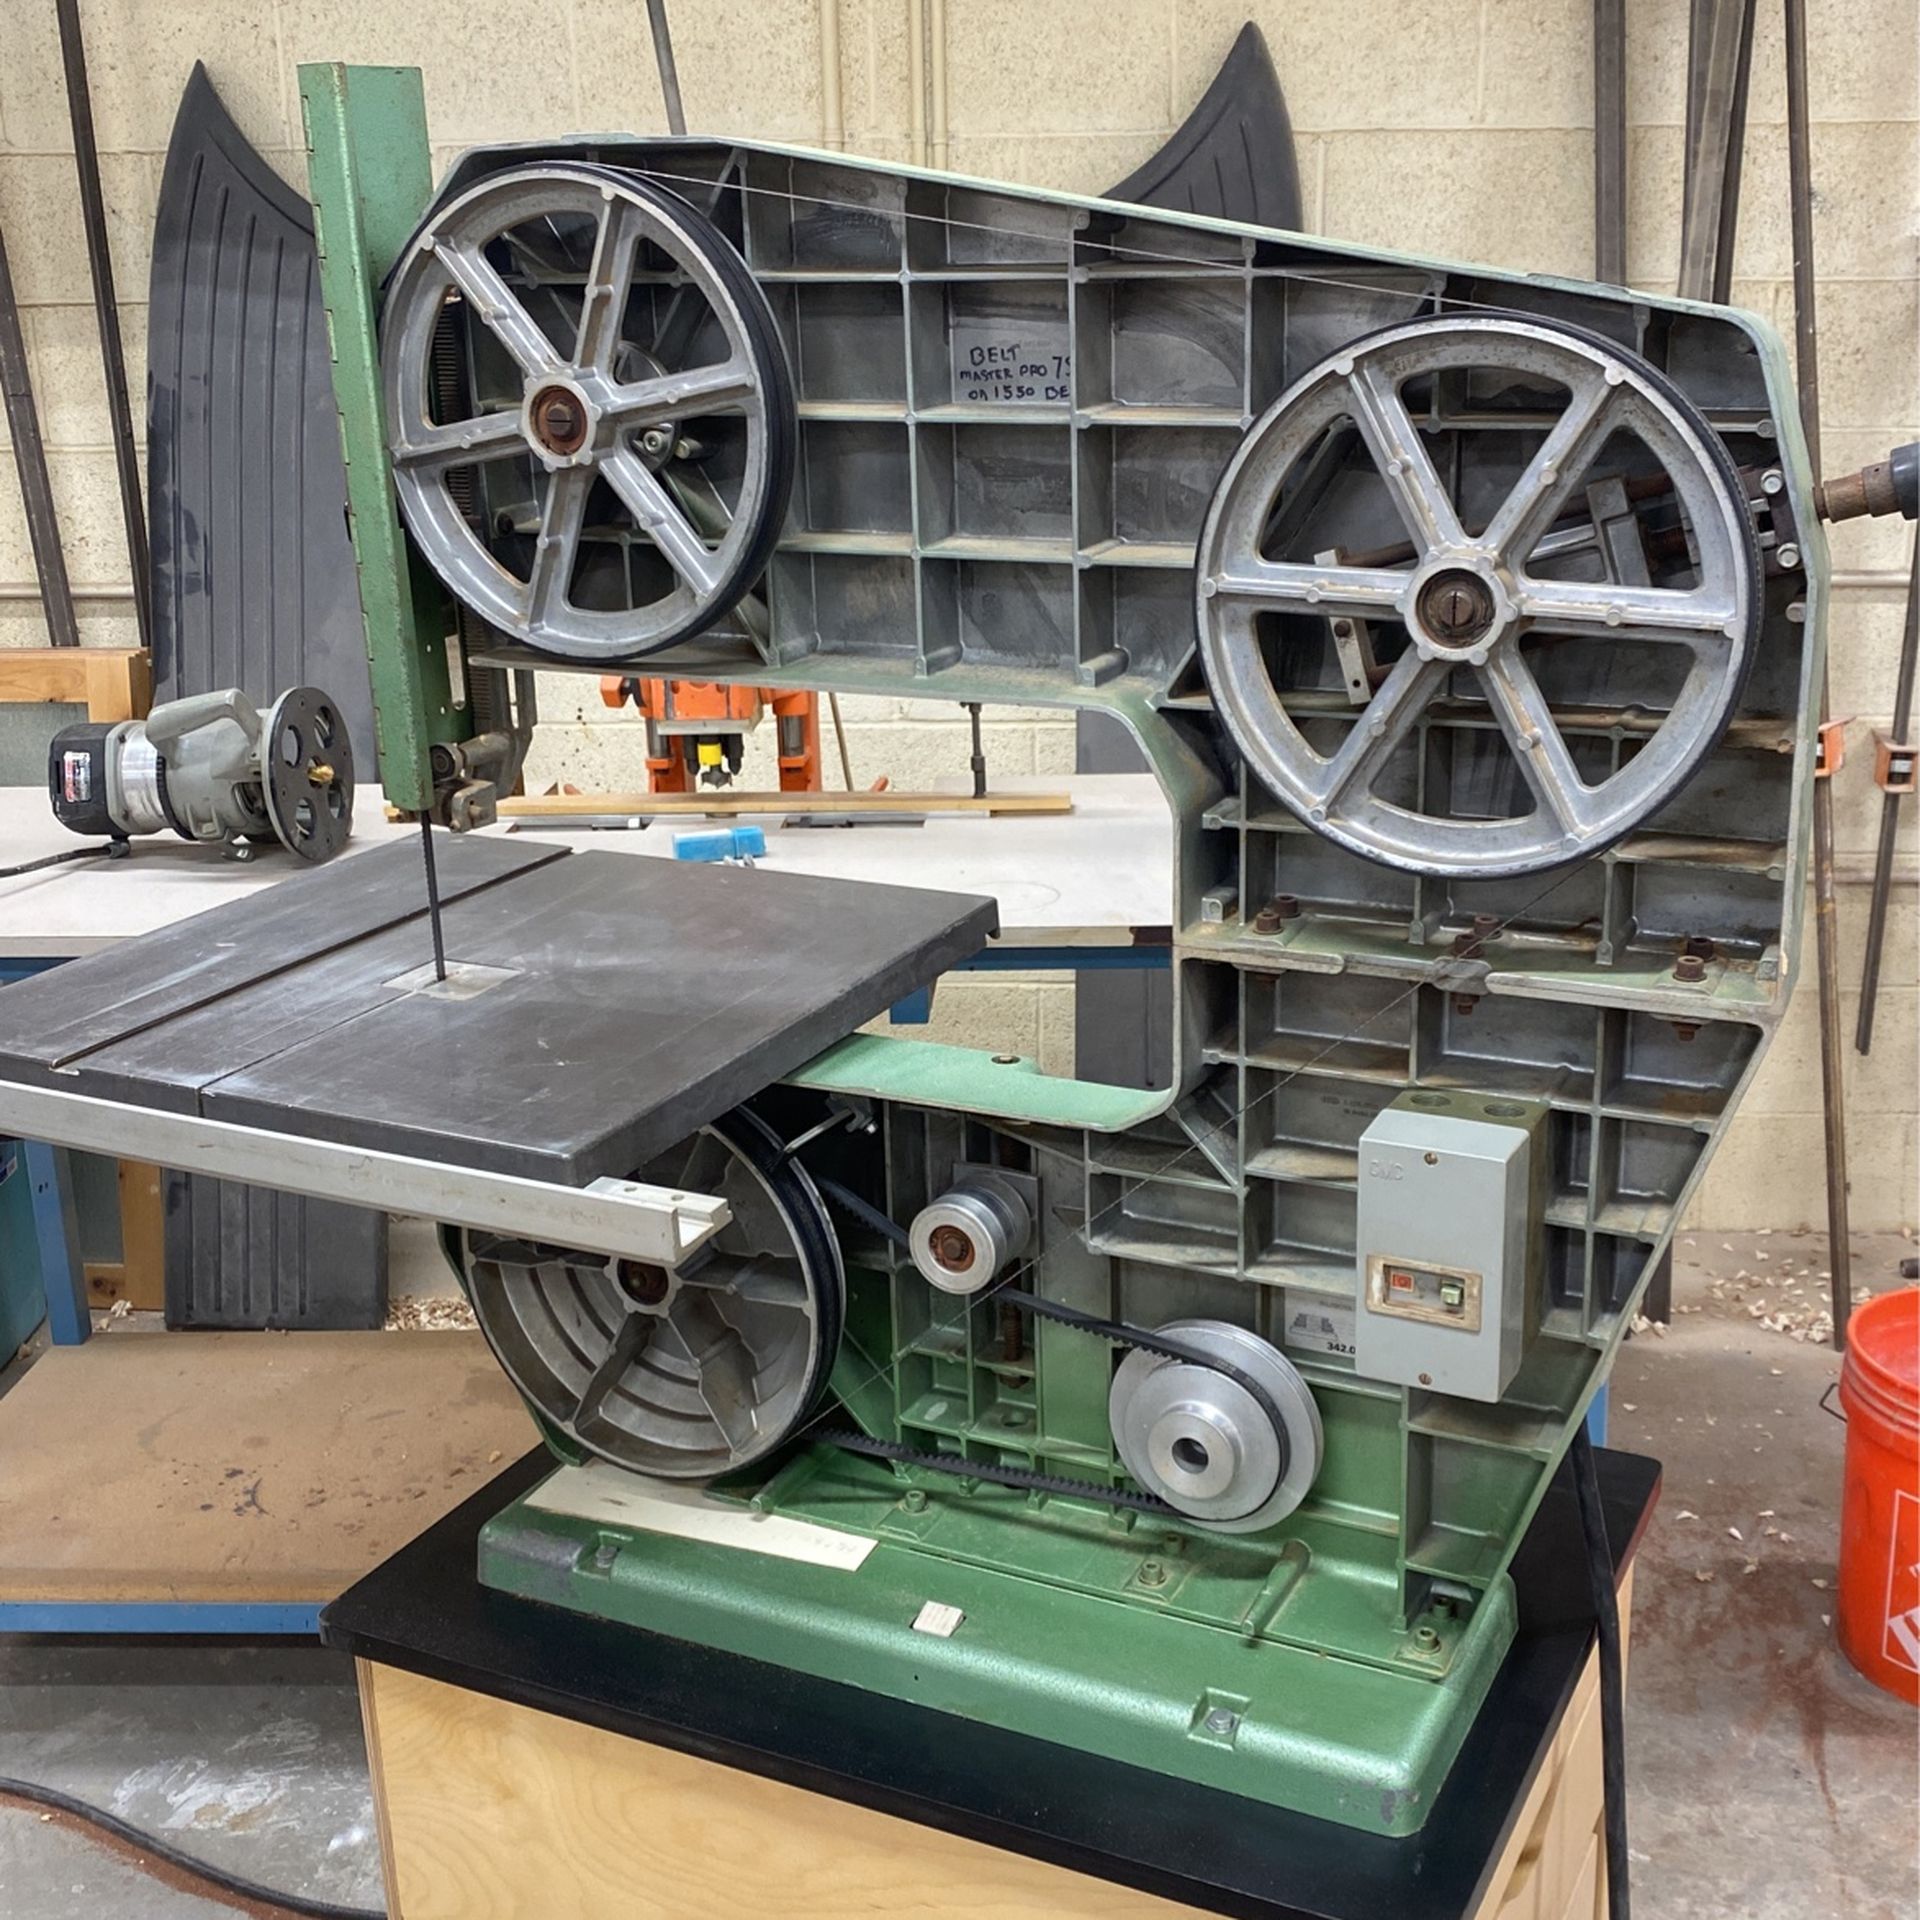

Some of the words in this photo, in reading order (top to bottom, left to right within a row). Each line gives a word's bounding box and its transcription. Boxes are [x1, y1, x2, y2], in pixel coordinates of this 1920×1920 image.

[970, 344, 1020, 366] BELT
[1019, 364, 1047, 377] PRO
[994, 385, 1035, 400] 1550
